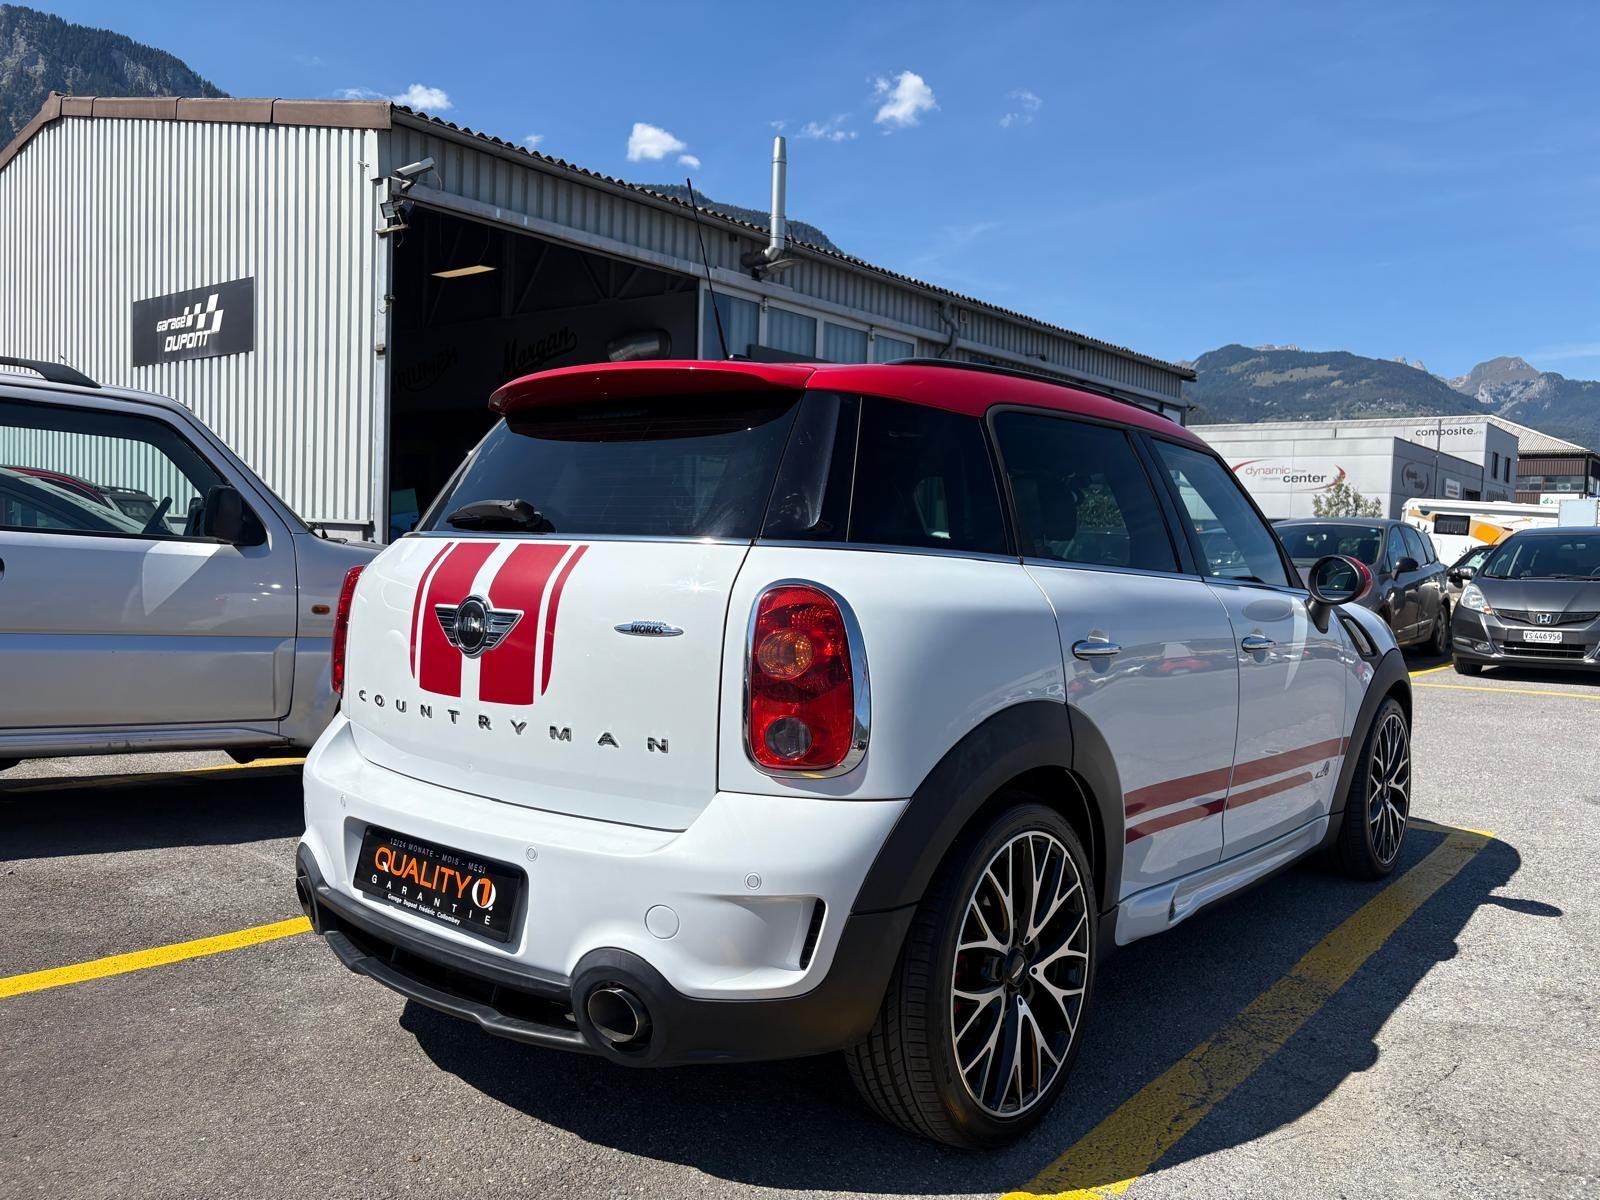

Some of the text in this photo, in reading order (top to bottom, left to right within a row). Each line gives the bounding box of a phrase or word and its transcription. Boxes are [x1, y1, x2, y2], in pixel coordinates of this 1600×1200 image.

[1245, 465, 1291, 477] dynamic
[1282, 473, 1327, 483] center
[631, 624, 664, 634] WORKS
[358, 689, 669, 754] COUNTRYMAN
[408, 843, 435, 858] MONATE
[441, 853, 460, 866] MOIS
[374, 847, 473, 899] QUALITY
[371, 874, 491, 926] GARANTIE
